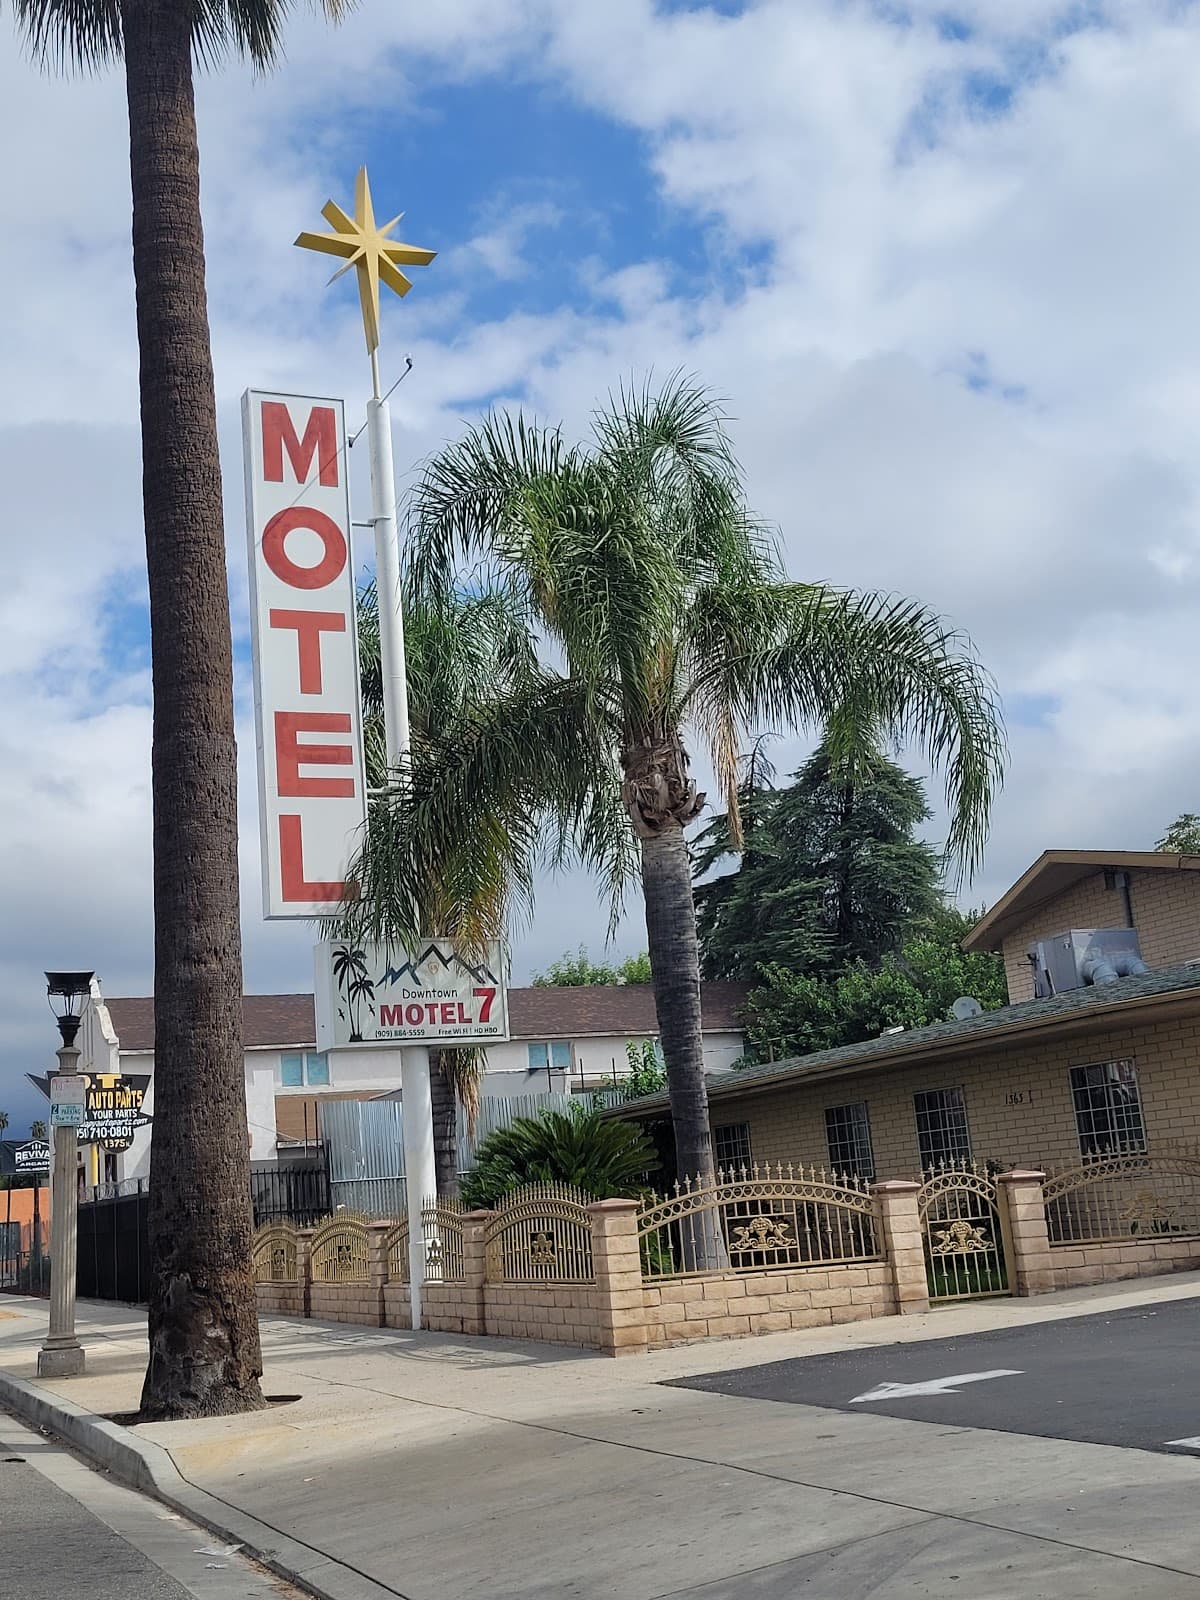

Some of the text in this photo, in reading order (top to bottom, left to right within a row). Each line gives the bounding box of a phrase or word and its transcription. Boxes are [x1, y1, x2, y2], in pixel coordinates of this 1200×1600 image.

[261, 401, 361, 902] MOTEL
[402, 988, 458, 999] Downtown
[380, 988, 496, 1026] MOTEL 7
[375, 1030, 393, 1038] (909)
[88, 1090, 143, 1109] AUTO PARTS
[52, 1104, 58, 1114] 2
[92, 1110, 113, 1120] YOUR
[115, 1109, 137, 1119] PARTS
[104, 1139, 126, 1148] 1375
[15, 1150, 51, 1165] REVIVA
